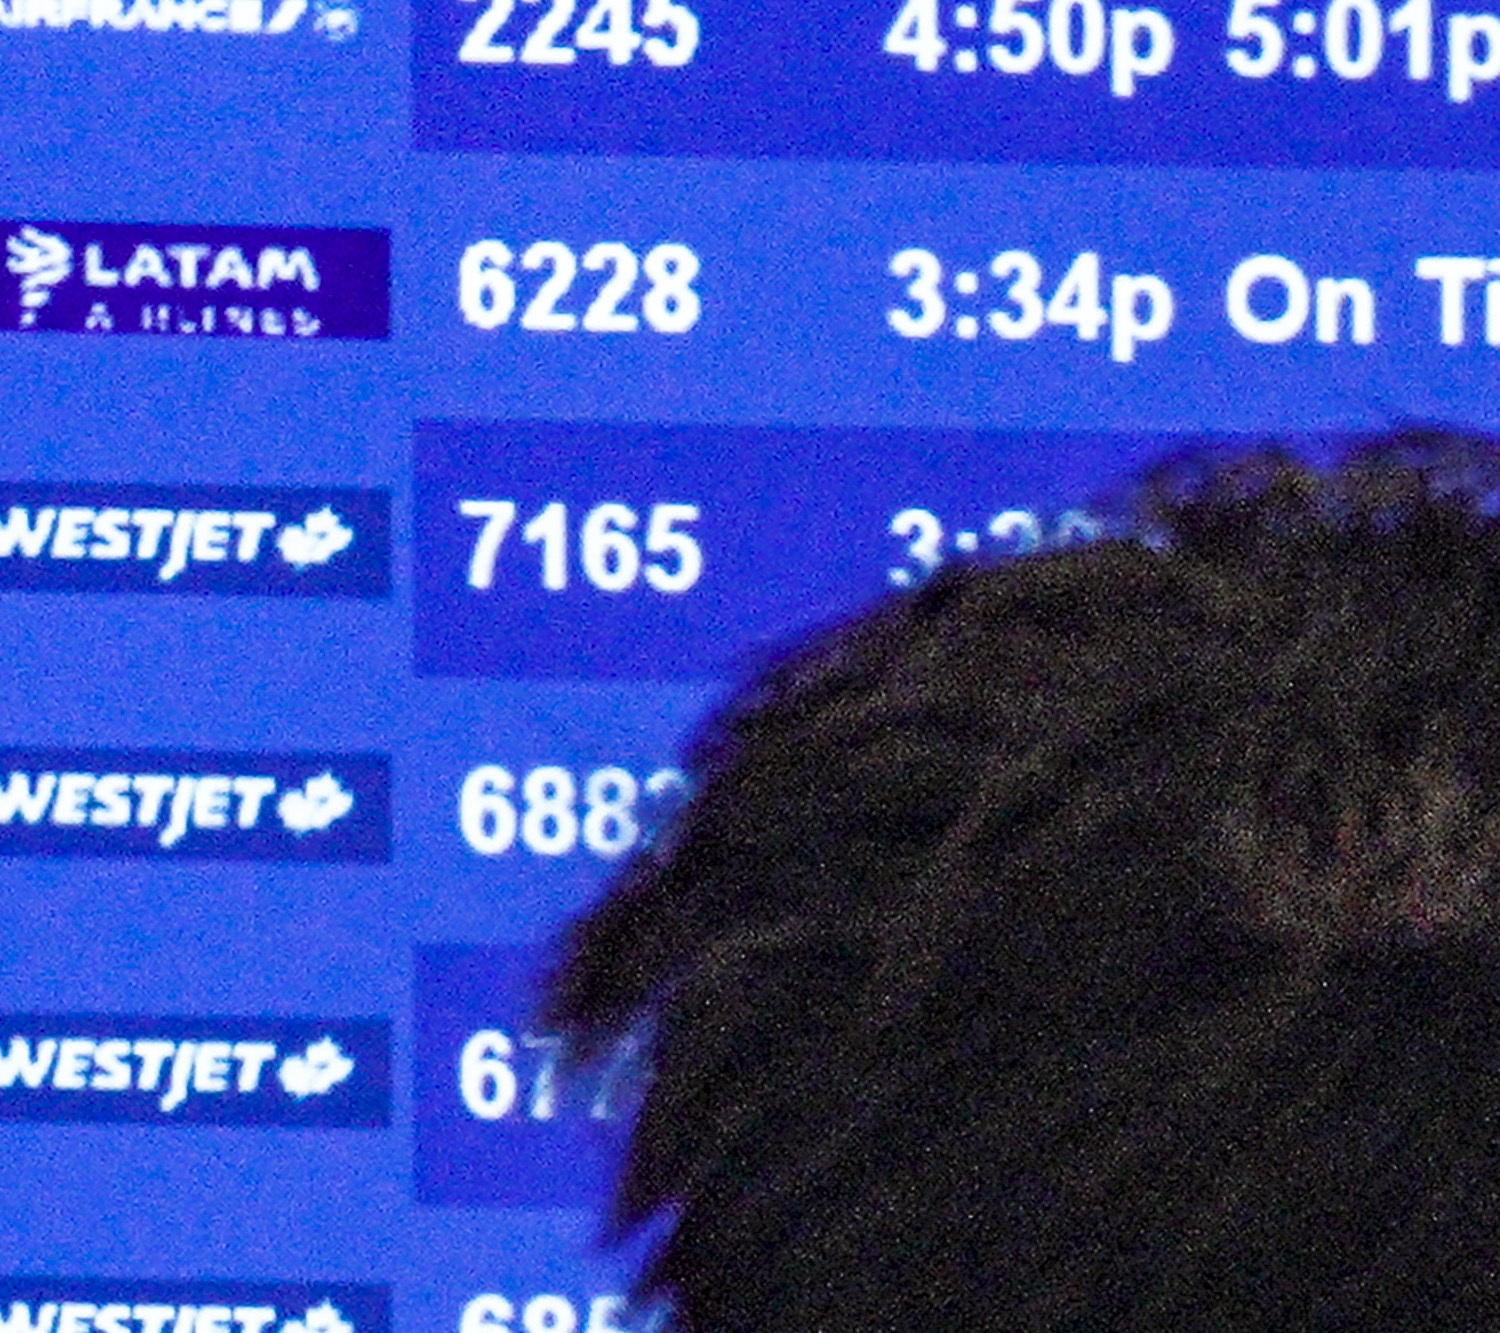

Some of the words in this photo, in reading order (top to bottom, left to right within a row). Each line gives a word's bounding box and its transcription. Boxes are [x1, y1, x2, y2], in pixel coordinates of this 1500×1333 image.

[457, 0, 700, 69] 2245
[882, 0, 1177, 100] 4:50p
[84, 243, 320, 292] LATAM
[456, 238, 702, 336] 6228
[886, 247, 1177, 365] 3:34p
[1224, 253, 1377, 347] On
[0, 506, 277, 582] WESTJET
[458, 499, 704, 595] 7165
[0, 771, 277, 848] WESTJET
[0, 1035, 277, 1113] WESTJET
